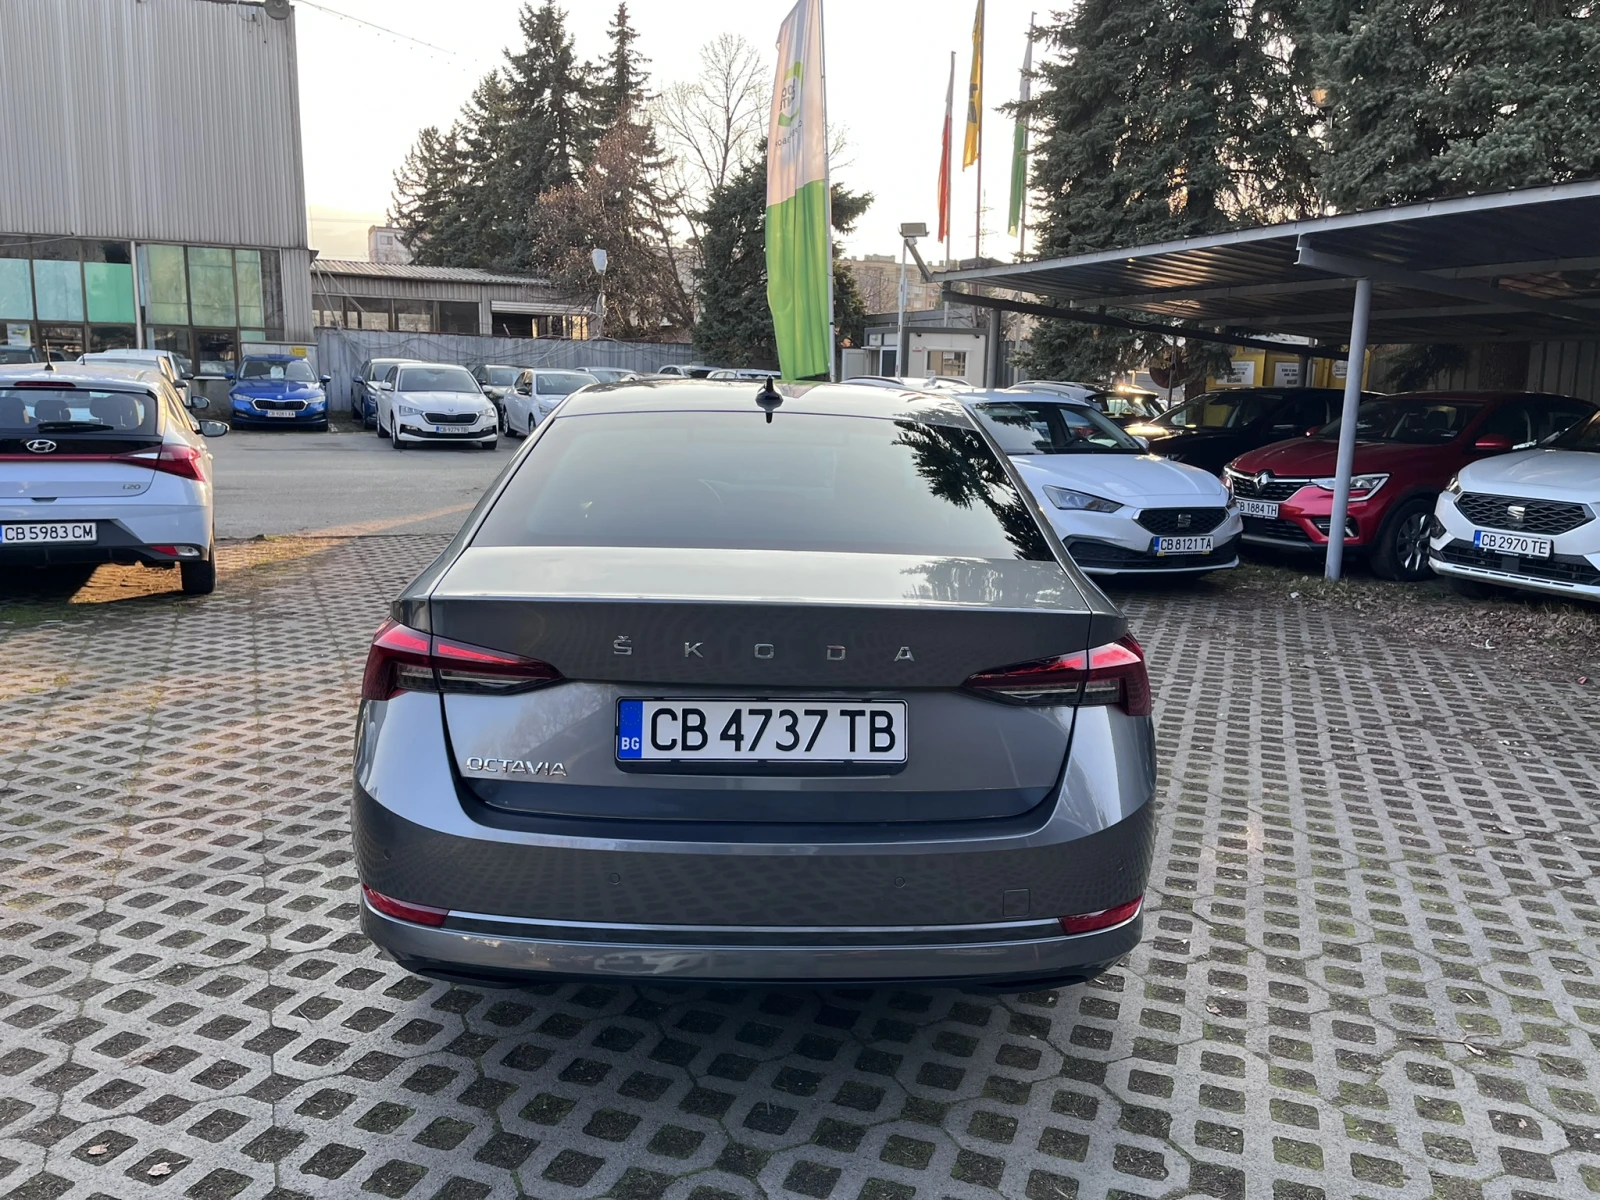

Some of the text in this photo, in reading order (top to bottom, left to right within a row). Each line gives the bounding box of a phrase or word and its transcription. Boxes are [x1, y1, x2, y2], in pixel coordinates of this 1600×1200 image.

[1266, 505, 1277, 515] TH
[4, 525, 93, 541] CB 5983 CM
[1160, 538, 1211, 550] CB 8121 TA
[1481, 534, 1548, 555] CB 2970 TE
[613, 635, 915, 662] ŠKODA
[650, 708, 896, 753] CB 4737 TB
[621, 736, 640, 750] BG
[466, 756, 568, 777] OCTAVIA
